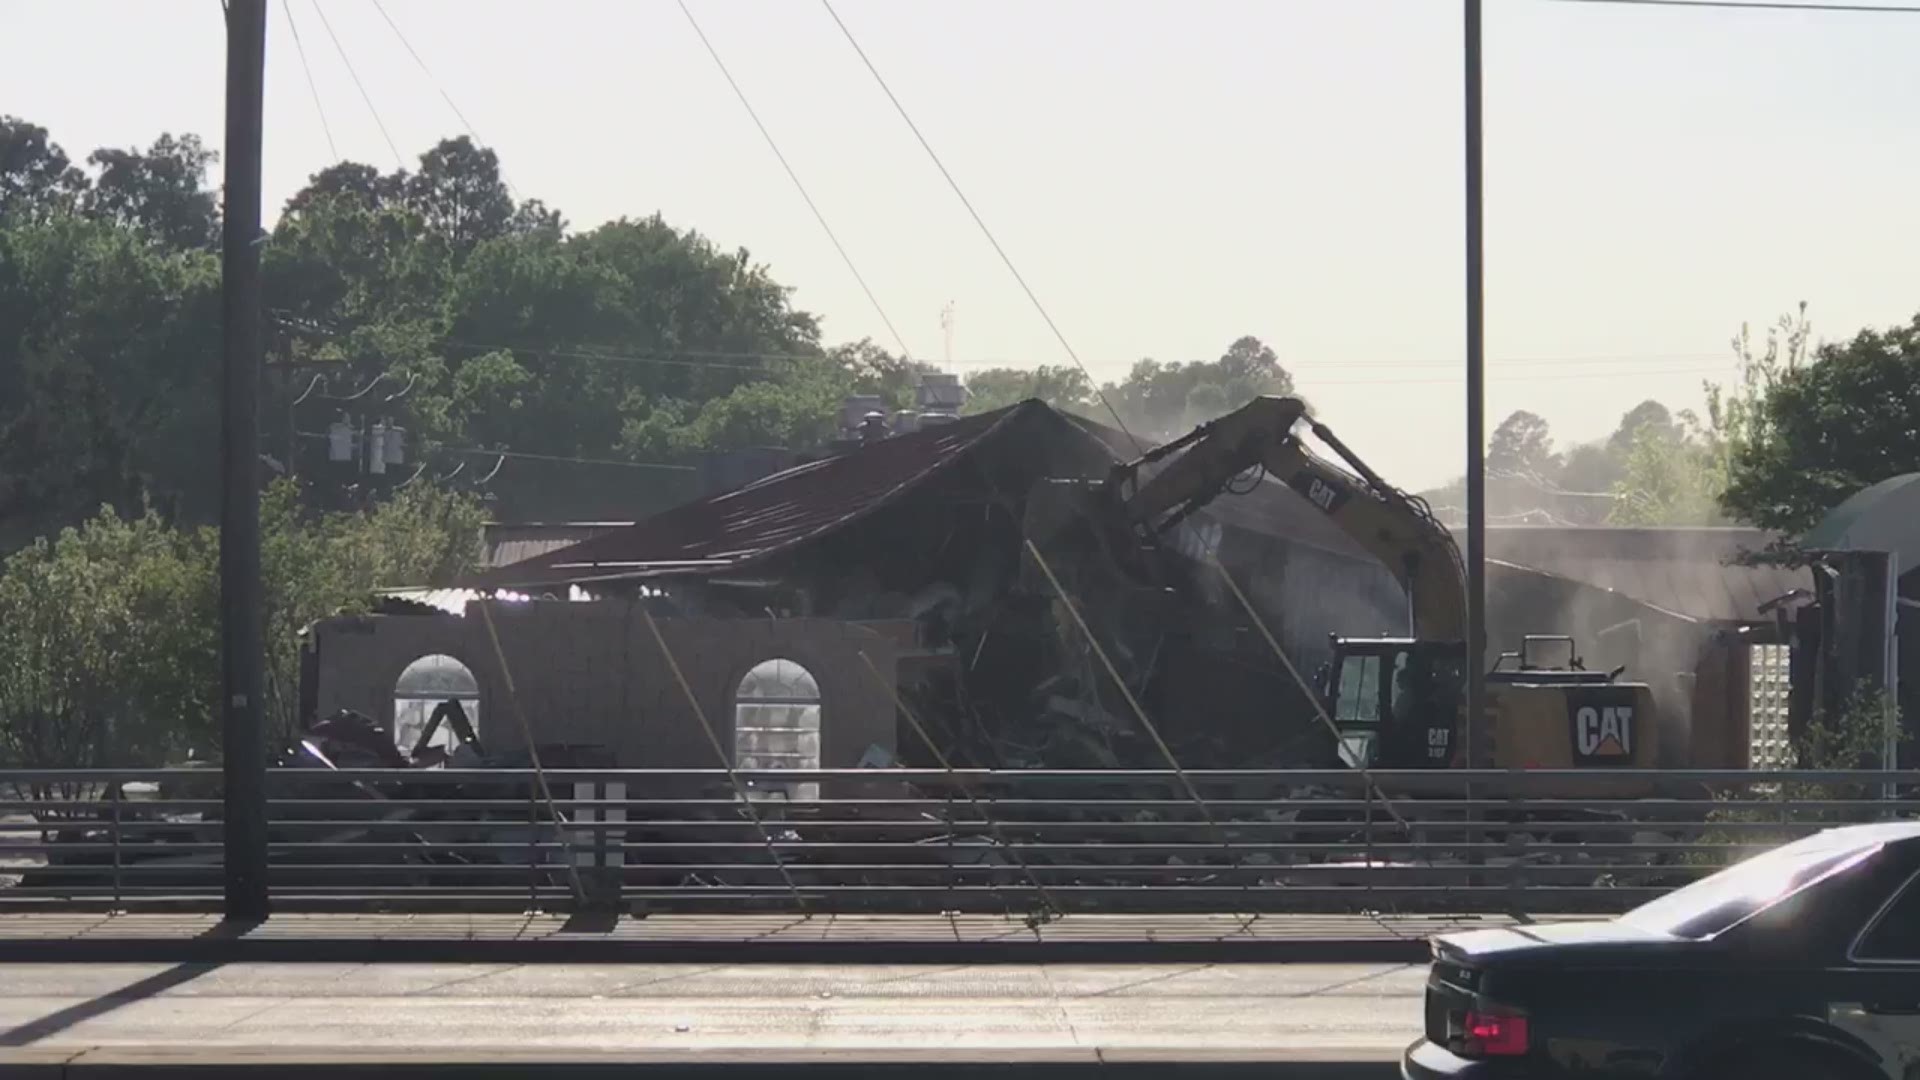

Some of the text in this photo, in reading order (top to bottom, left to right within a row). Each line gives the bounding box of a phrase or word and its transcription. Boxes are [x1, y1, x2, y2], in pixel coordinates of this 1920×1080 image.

[1309, 479, 1336, 510] CAT
[1428, 728, 1450, 745] CAT
[1577, 707, 1633, 755] CAT
